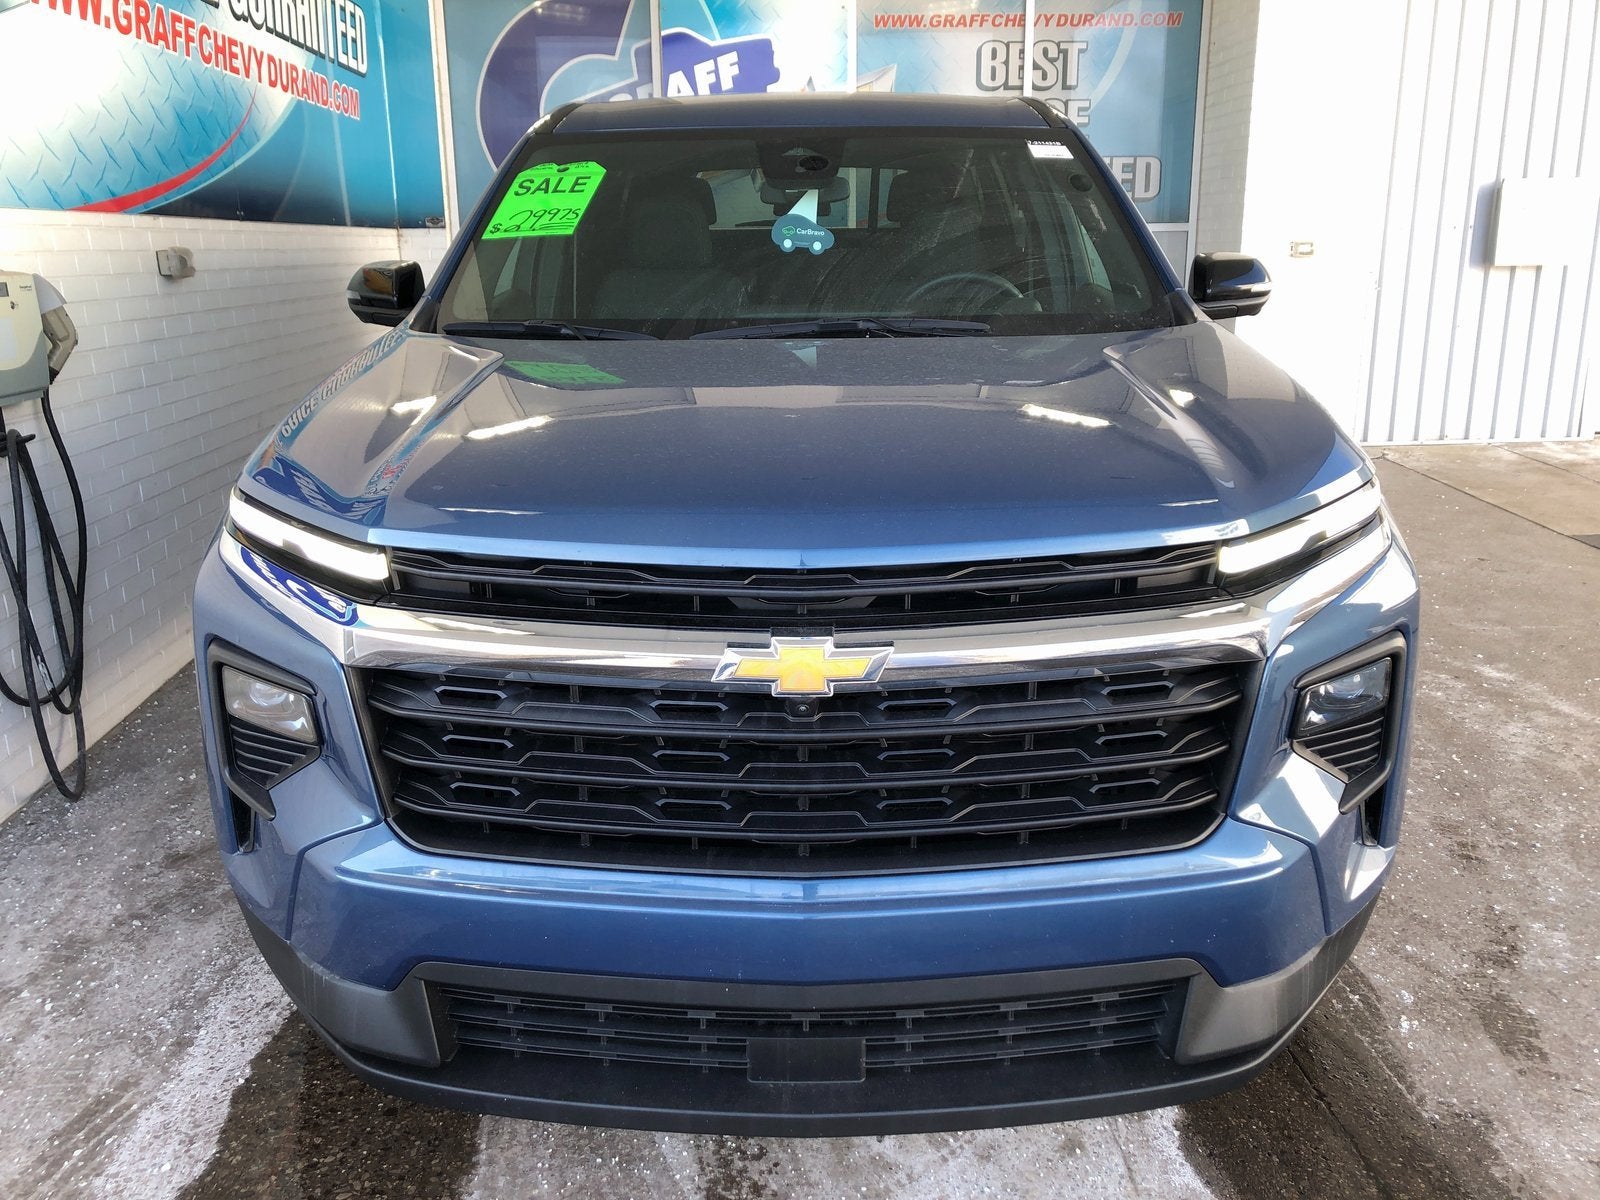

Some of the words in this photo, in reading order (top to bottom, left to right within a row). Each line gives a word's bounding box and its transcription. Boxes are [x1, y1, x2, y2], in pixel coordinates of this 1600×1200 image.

[976, 40, 1088, 91] BEST
[514, 176, 591, 196] SALE
[796, 228, 825, 236] CarBravo
